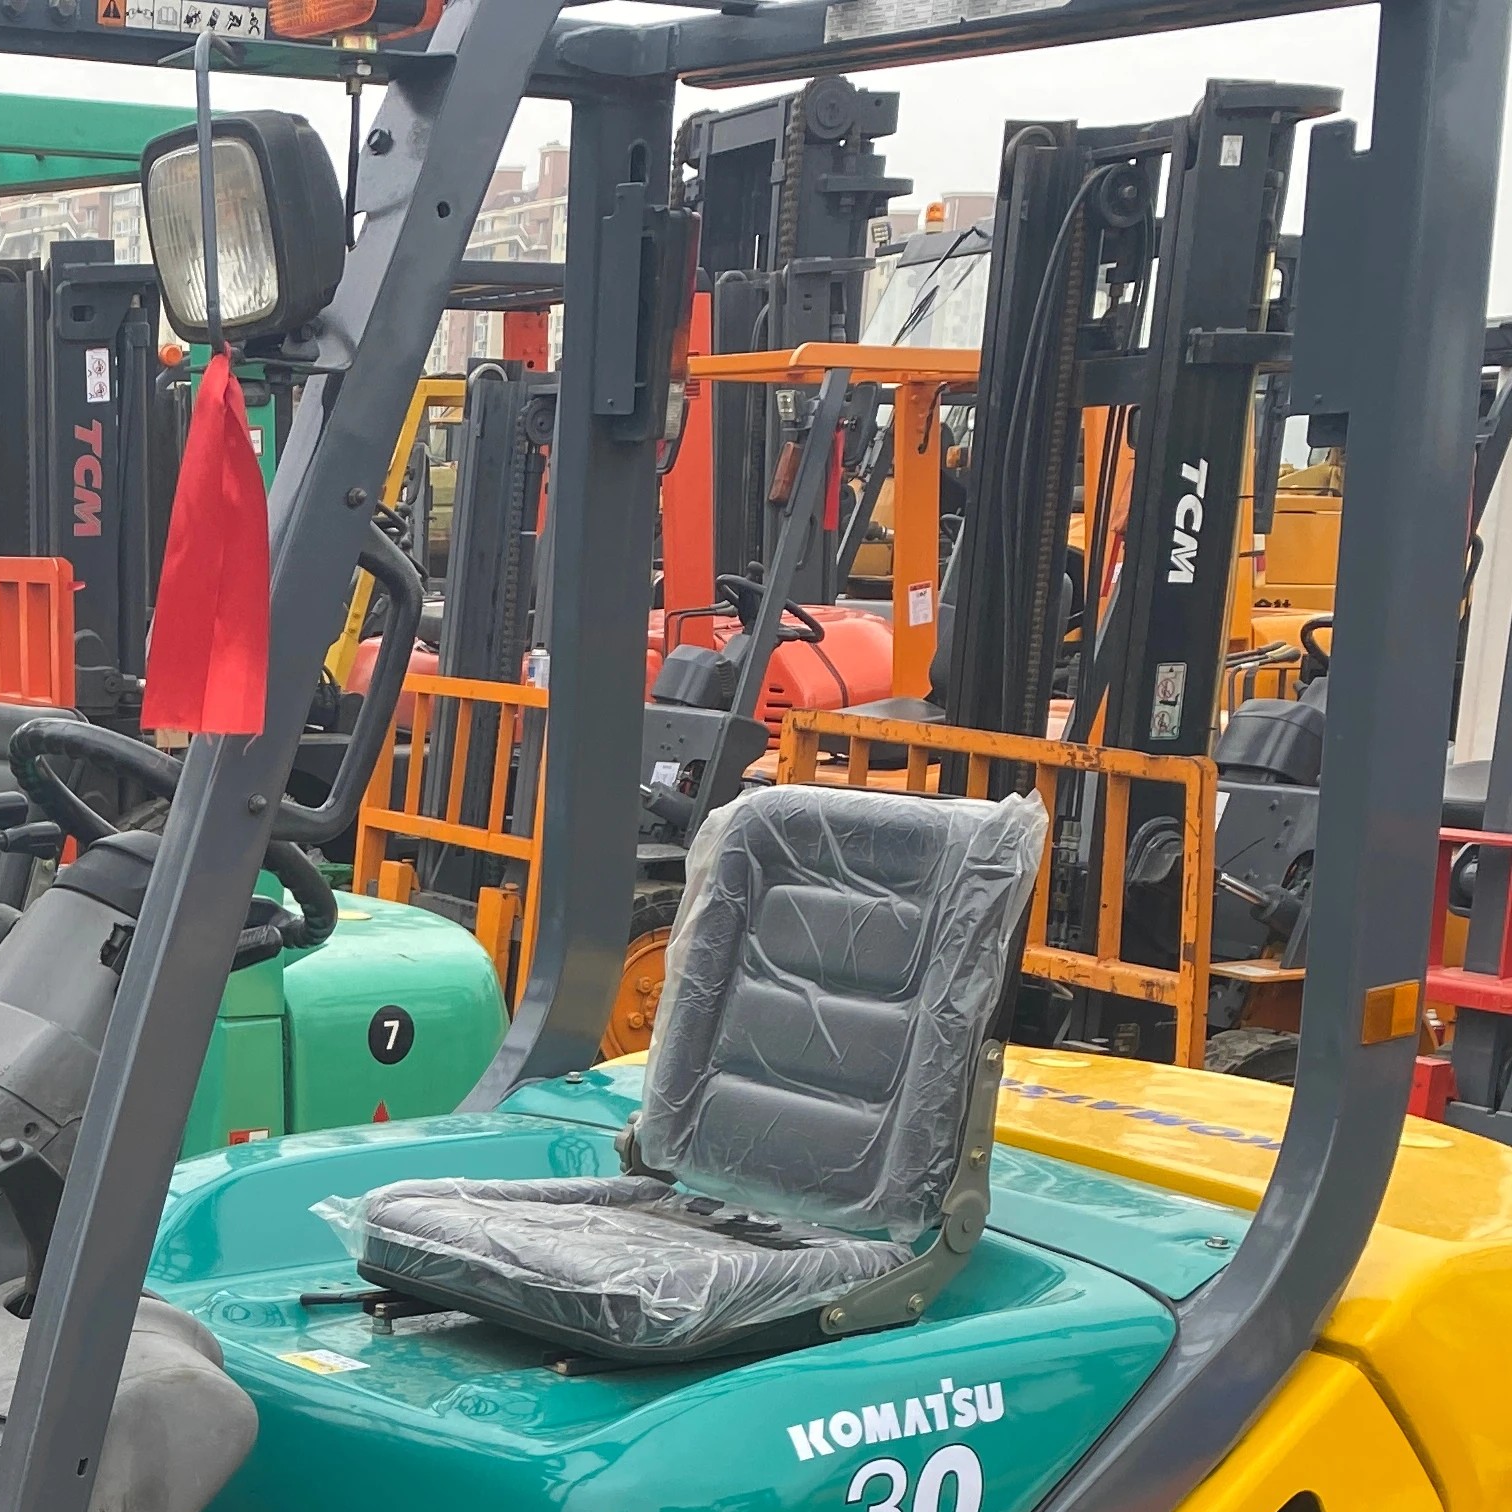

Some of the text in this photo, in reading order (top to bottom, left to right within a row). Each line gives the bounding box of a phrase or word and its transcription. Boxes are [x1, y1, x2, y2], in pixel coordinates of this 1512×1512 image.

[74, 419, 103, 537] TCM
[1167, 457, 1209, 583] TCM
[383, 1020, 400, 1051] 7
[786, 1377, 1006, 1462] KOMATSU
